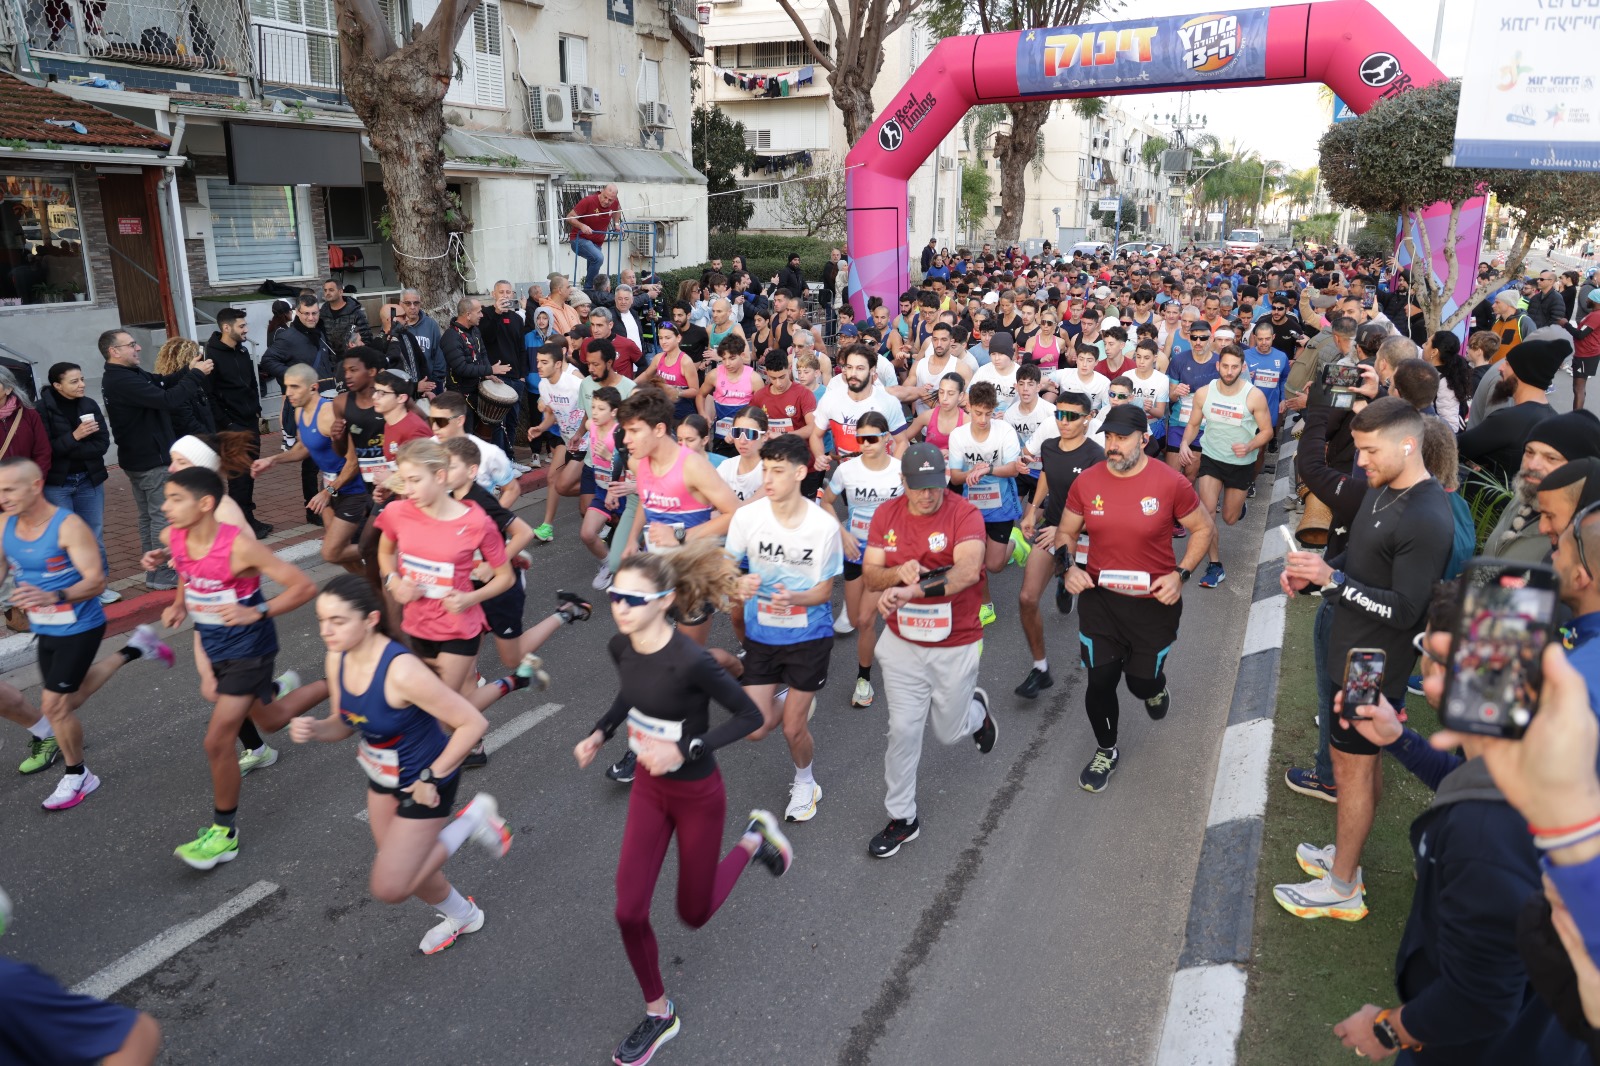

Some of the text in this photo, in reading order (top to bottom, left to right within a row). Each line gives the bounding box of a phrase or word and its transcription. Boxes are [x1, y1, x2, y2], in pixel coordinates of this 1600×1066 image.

[1177, 16, 1237, 50] מרוץ
[1194, 30, 1236, 48] אור יהודה
[1044, 27, 1158, 77] זינוק
[895, 92, 919, 122] Real
[900, 92, 937, 132] Timing
[1352, 591, 1392, 618] Hurley
[912, 617, 936, 628] 1576
